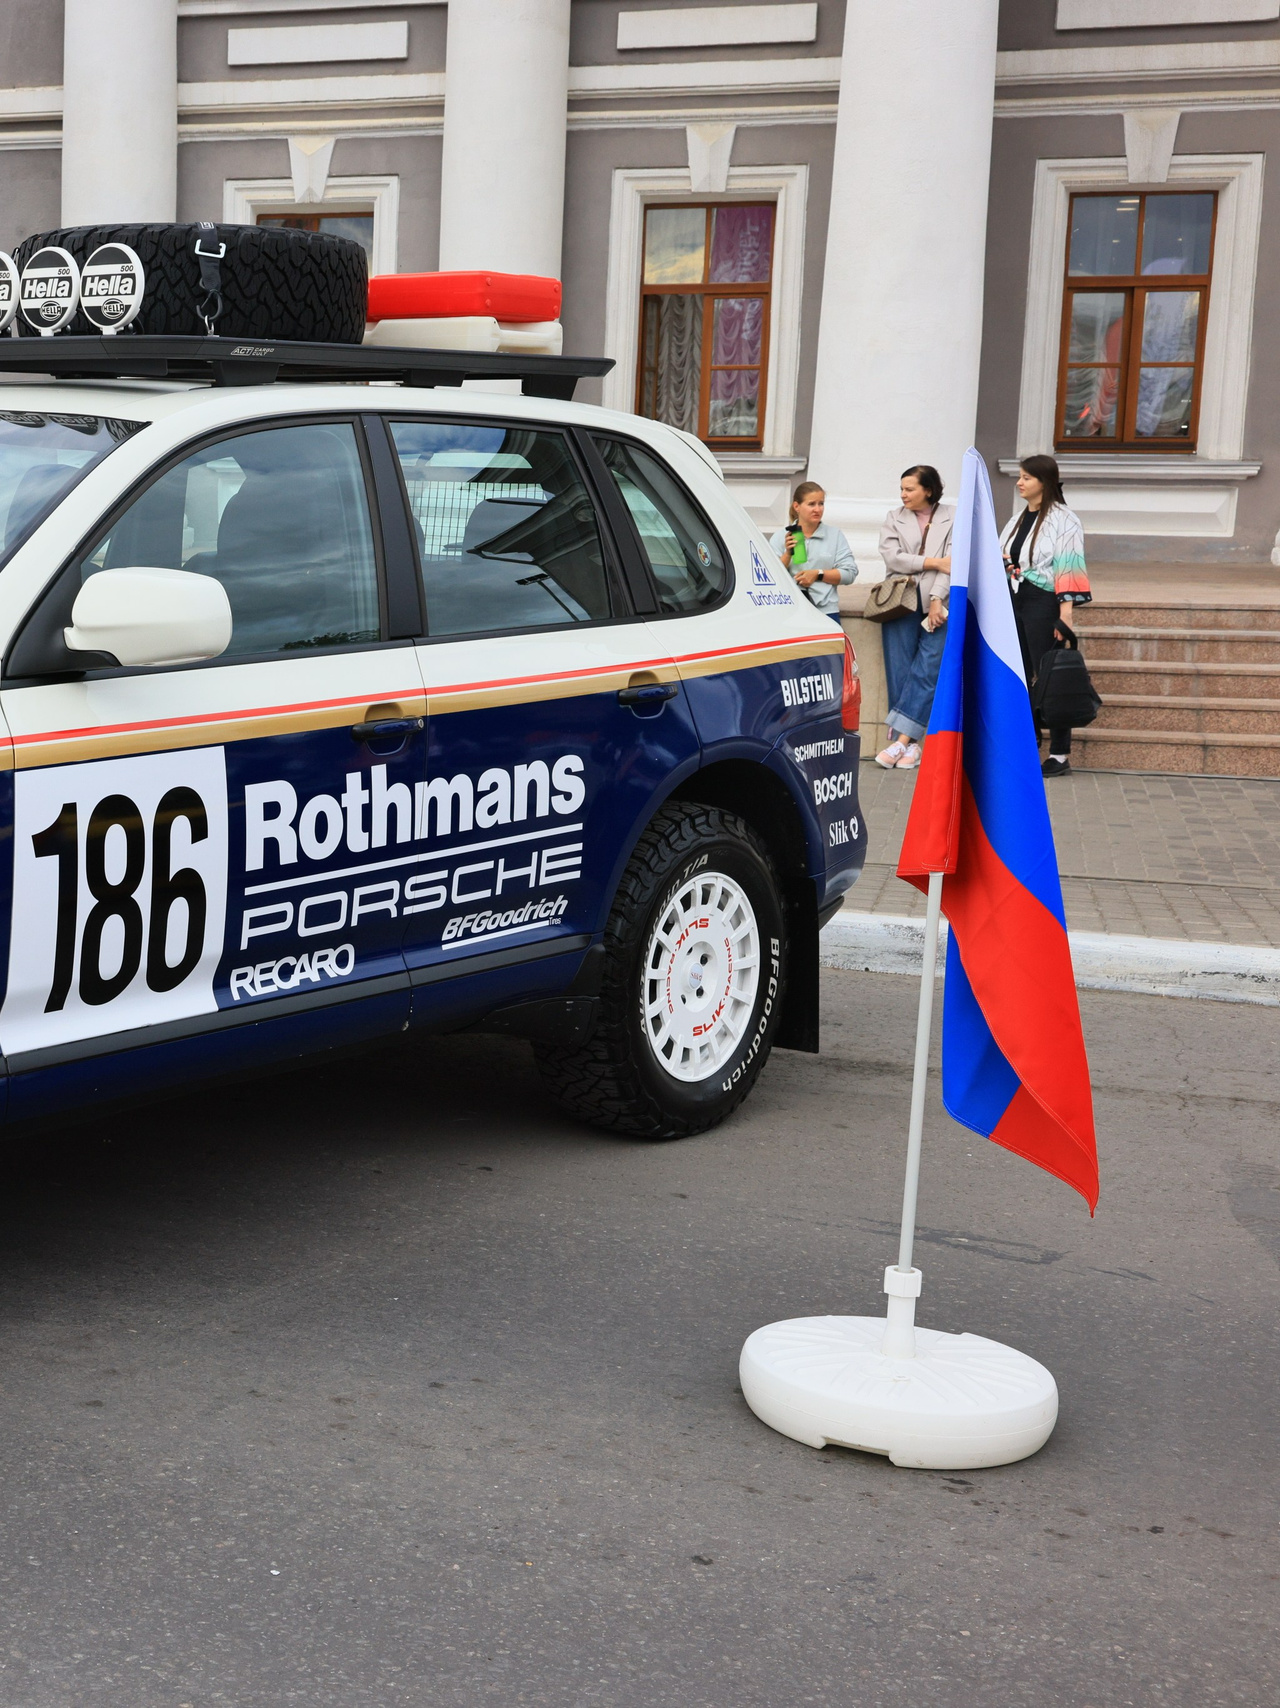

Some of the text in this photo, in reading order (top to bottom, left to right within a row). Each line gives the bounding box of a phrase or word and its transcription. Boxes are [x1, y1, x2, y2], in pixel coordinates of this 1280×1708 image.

[23, 278, 70, 298] Hella
[84, 275, 134, 296] Hella
[41, 306, 62, 315] HELLA
[103, 304, 125, 312] HELLA
[746, 590, 795, 607] Turbolader
[780, 673, 834, 707] BILSTEIN
[795, 738, 844, 763] SCHMITTHELM
[814, 772, 852, 805] BOSCH
[244, 754, 585, 872] Rothmans
[829, 819, 849, 847] Slik
[684, 853, 709, 875] T/A
[31, 786, 209, 1014] 186
[240, 842, 583, 951] PORSCHE
[441, 895, 569, 941] BFGoodrich
[549, 917, 562, 926] Tires
[230, 943, 354, 1001] RECARO
[722, 937, 780, 1092] BFGoodrich
